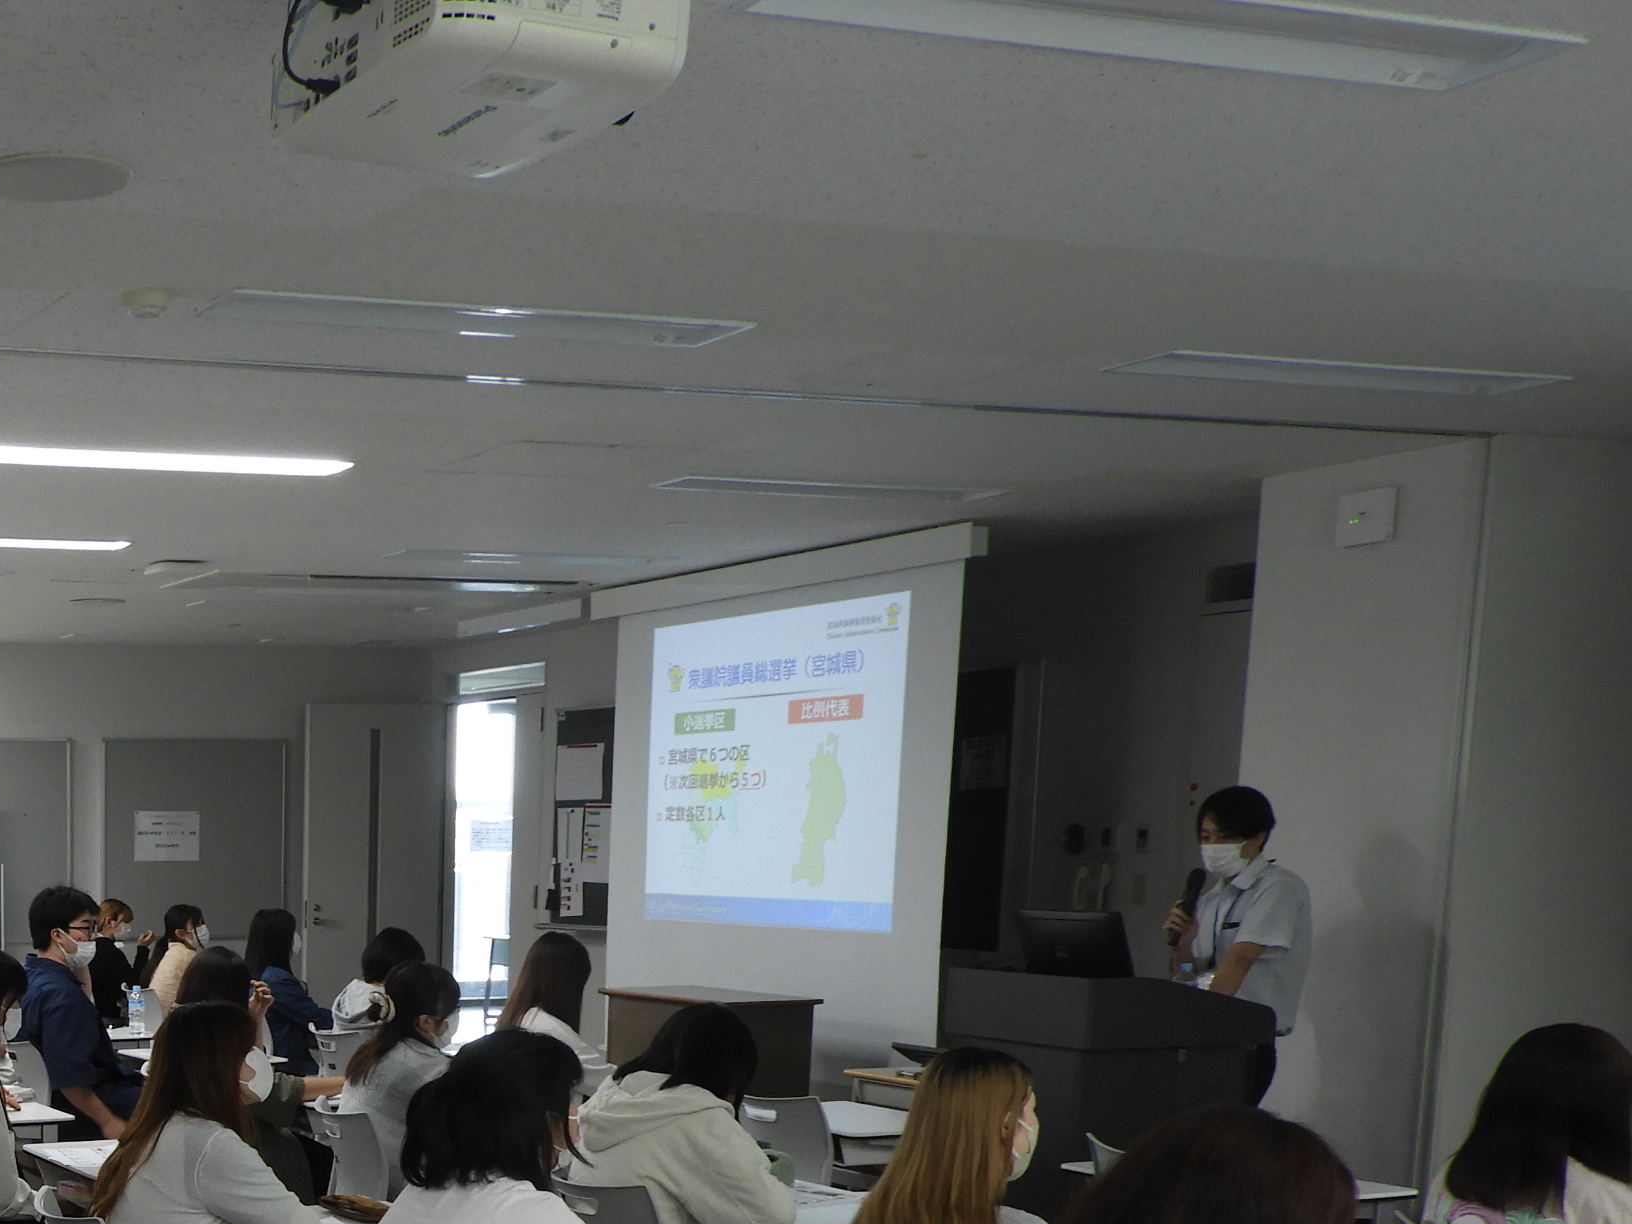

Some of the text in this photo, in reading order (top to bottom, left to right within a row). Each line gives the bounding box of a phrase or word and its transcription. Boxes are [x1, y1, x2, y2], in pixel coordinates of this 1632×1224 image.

[800, 699, 850, 720] 比例代表
[683, 712, 725, 732] 小選挙区
